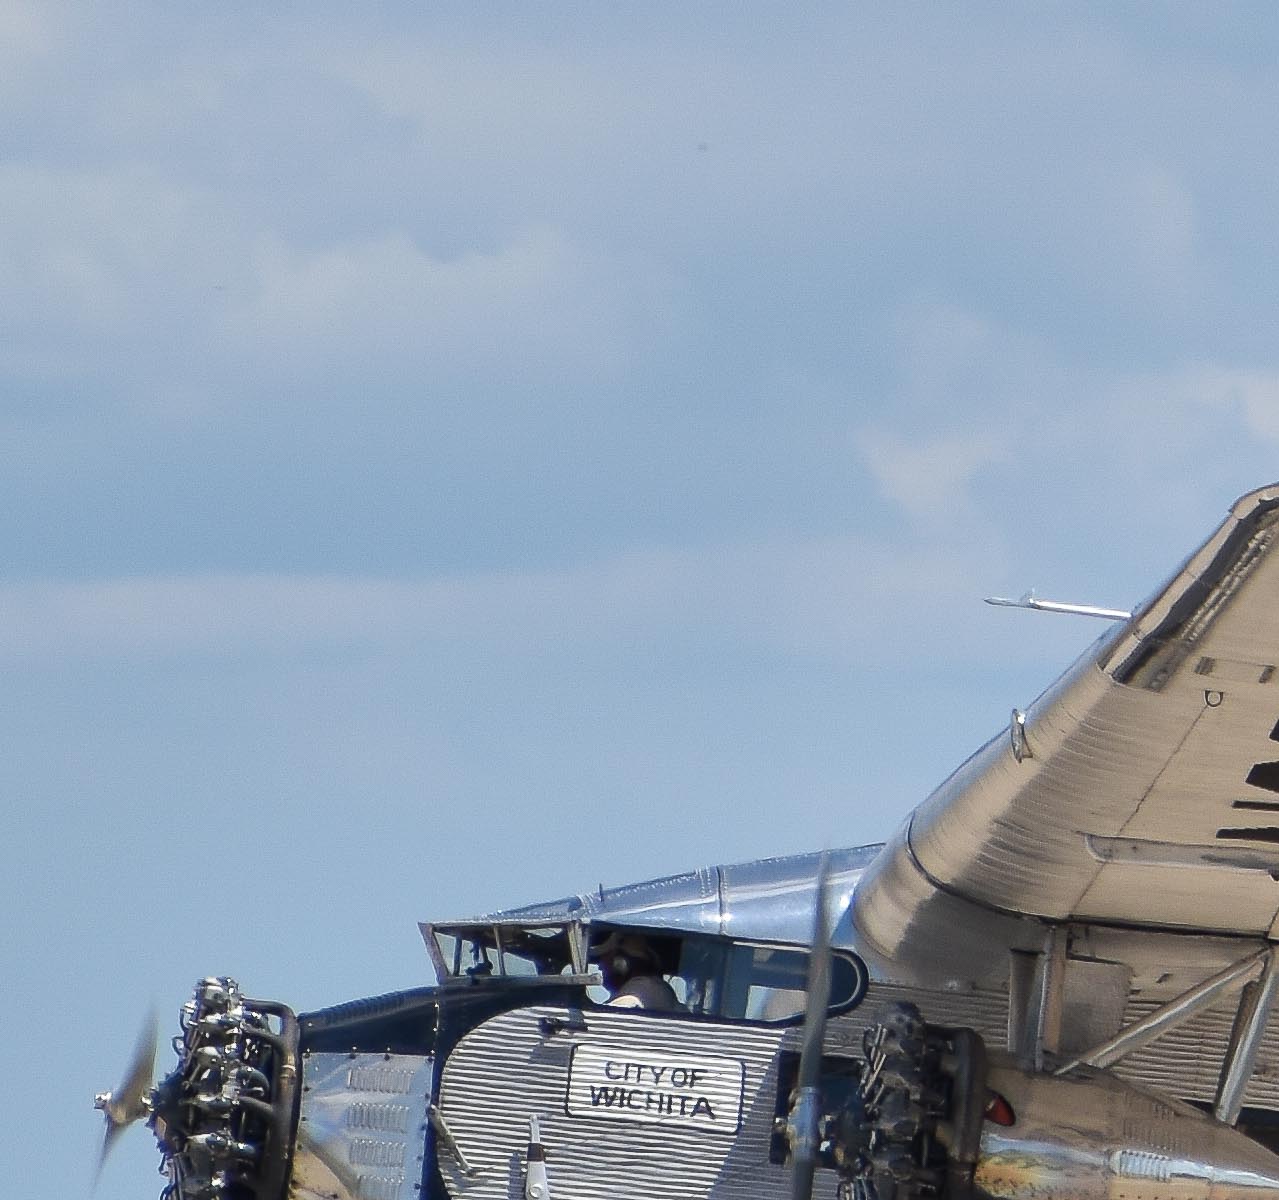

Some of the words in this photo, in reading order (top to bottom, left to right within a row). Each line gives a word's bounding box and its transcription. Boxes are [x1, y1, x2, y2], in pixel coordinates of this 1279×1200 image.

[605, 1060, 667, 1086] CITY
[671, 1067, 708, 1089] OF
[591, 1085, 715, 1120] WICHITA
